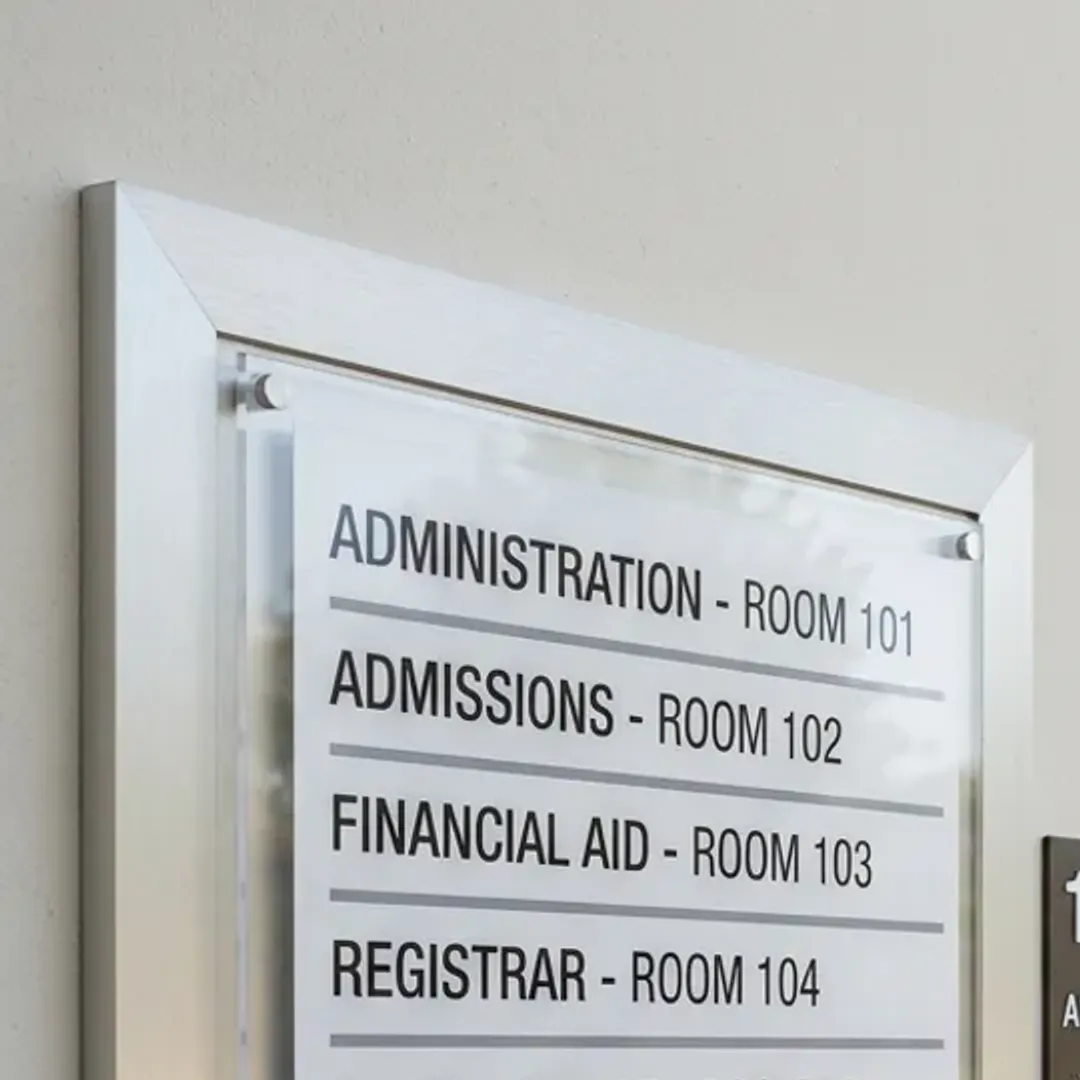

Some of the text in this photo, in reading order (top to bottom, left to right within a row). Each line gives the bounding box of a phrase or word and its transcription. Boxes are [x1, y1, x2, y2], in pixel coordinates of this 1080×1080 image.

[331, 506, 911, 656] ADMINISTRATION - ROOM 101
[330, 651, 841, 764] ADMISSIONS - ROOM 102
[334, 794, 871, 888] FINANCIAL AID - ROOM 103
[334, 940, 819, 1006] REGISTRAR - ROOM 104
